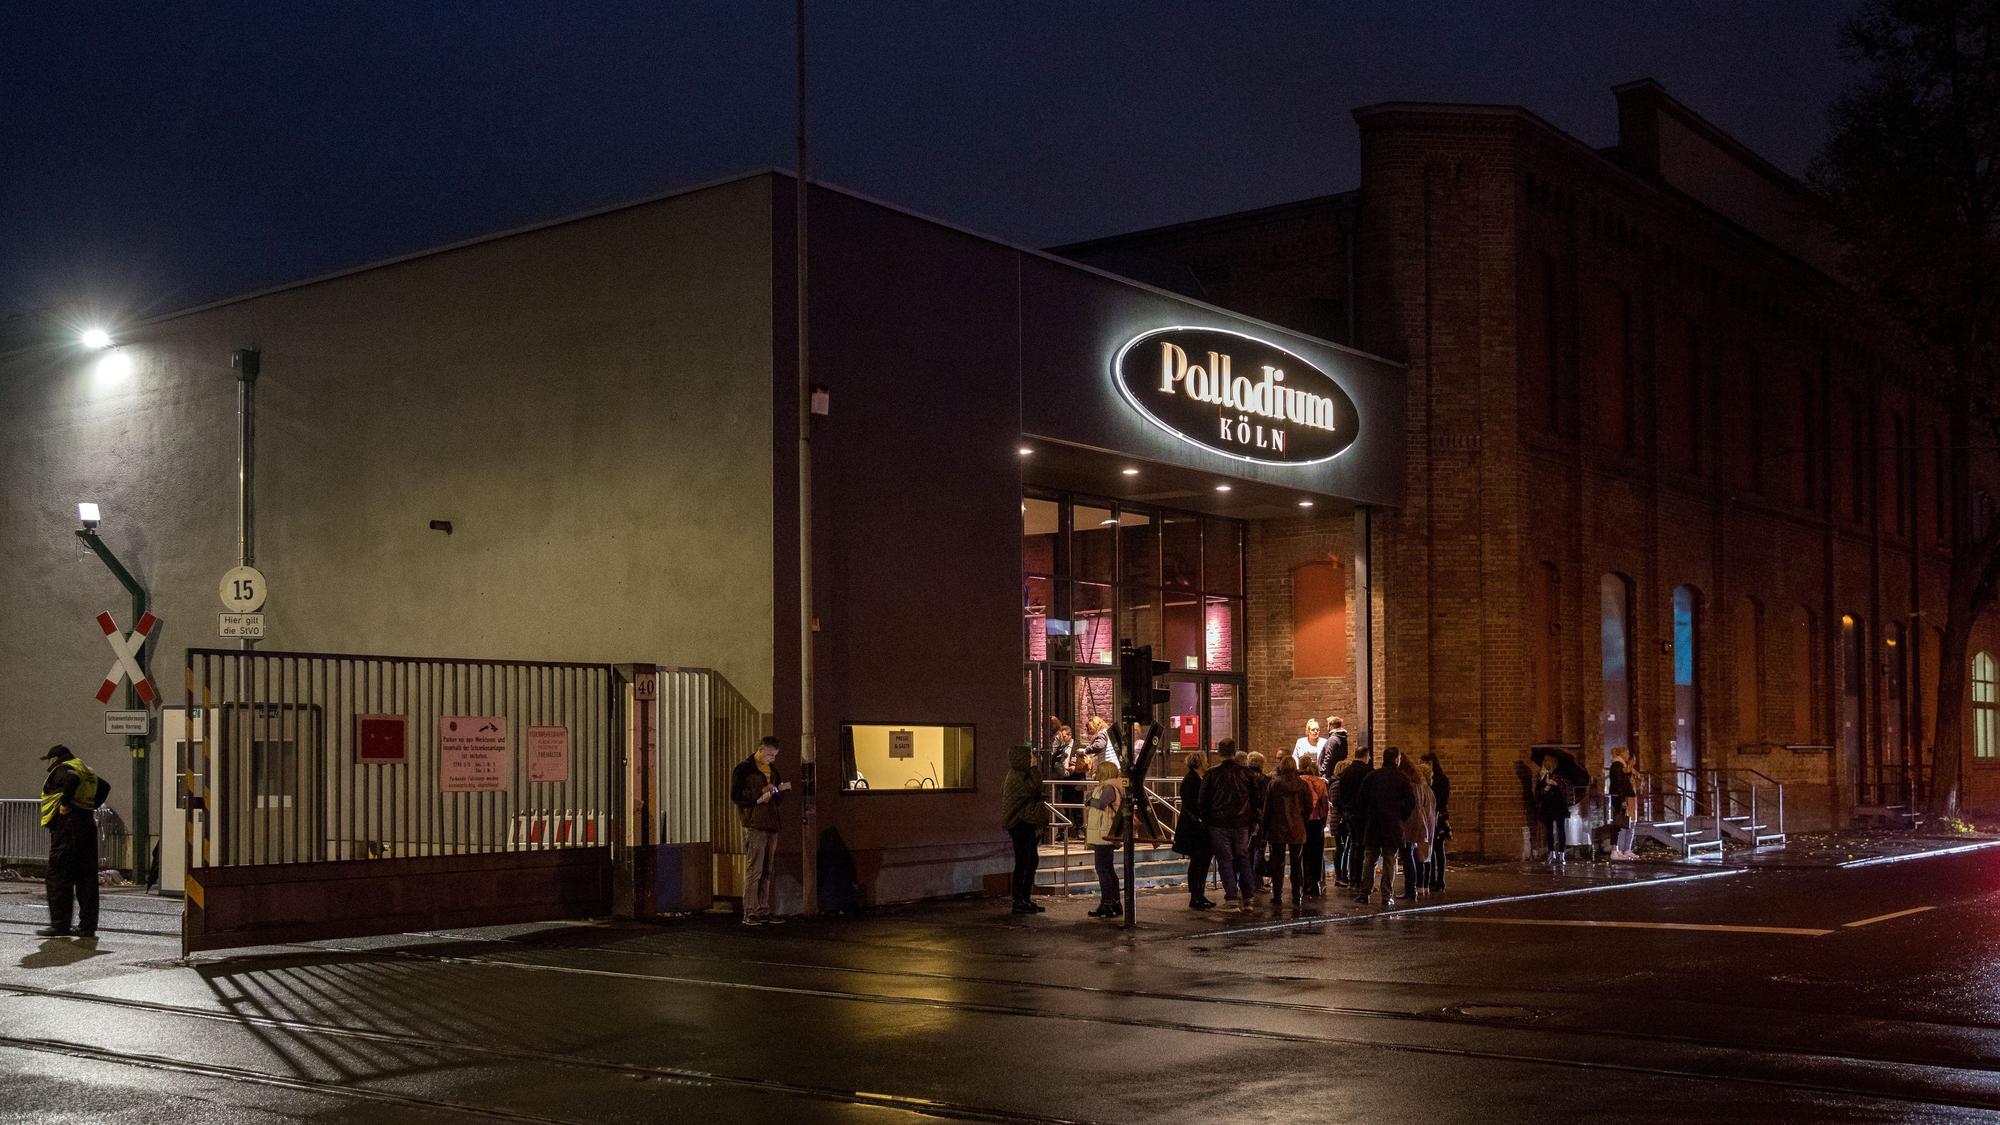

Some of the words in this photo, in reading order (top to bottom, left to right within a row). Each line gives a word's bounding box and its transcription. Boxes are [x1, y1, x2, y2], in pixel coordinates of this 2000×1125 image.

[1158, 341, 1336, 432] Palladium
[1220, 415, 1285, 452] KÖLN
[233, 580, 254, 600] 15
[224, 616, 241, 624] Hier
[246, 616, 259, 626] gilt
[223, 627, 236, 635] die
[240, 626, 260, 635] StVO
[638, 680, 655, 695] 40
